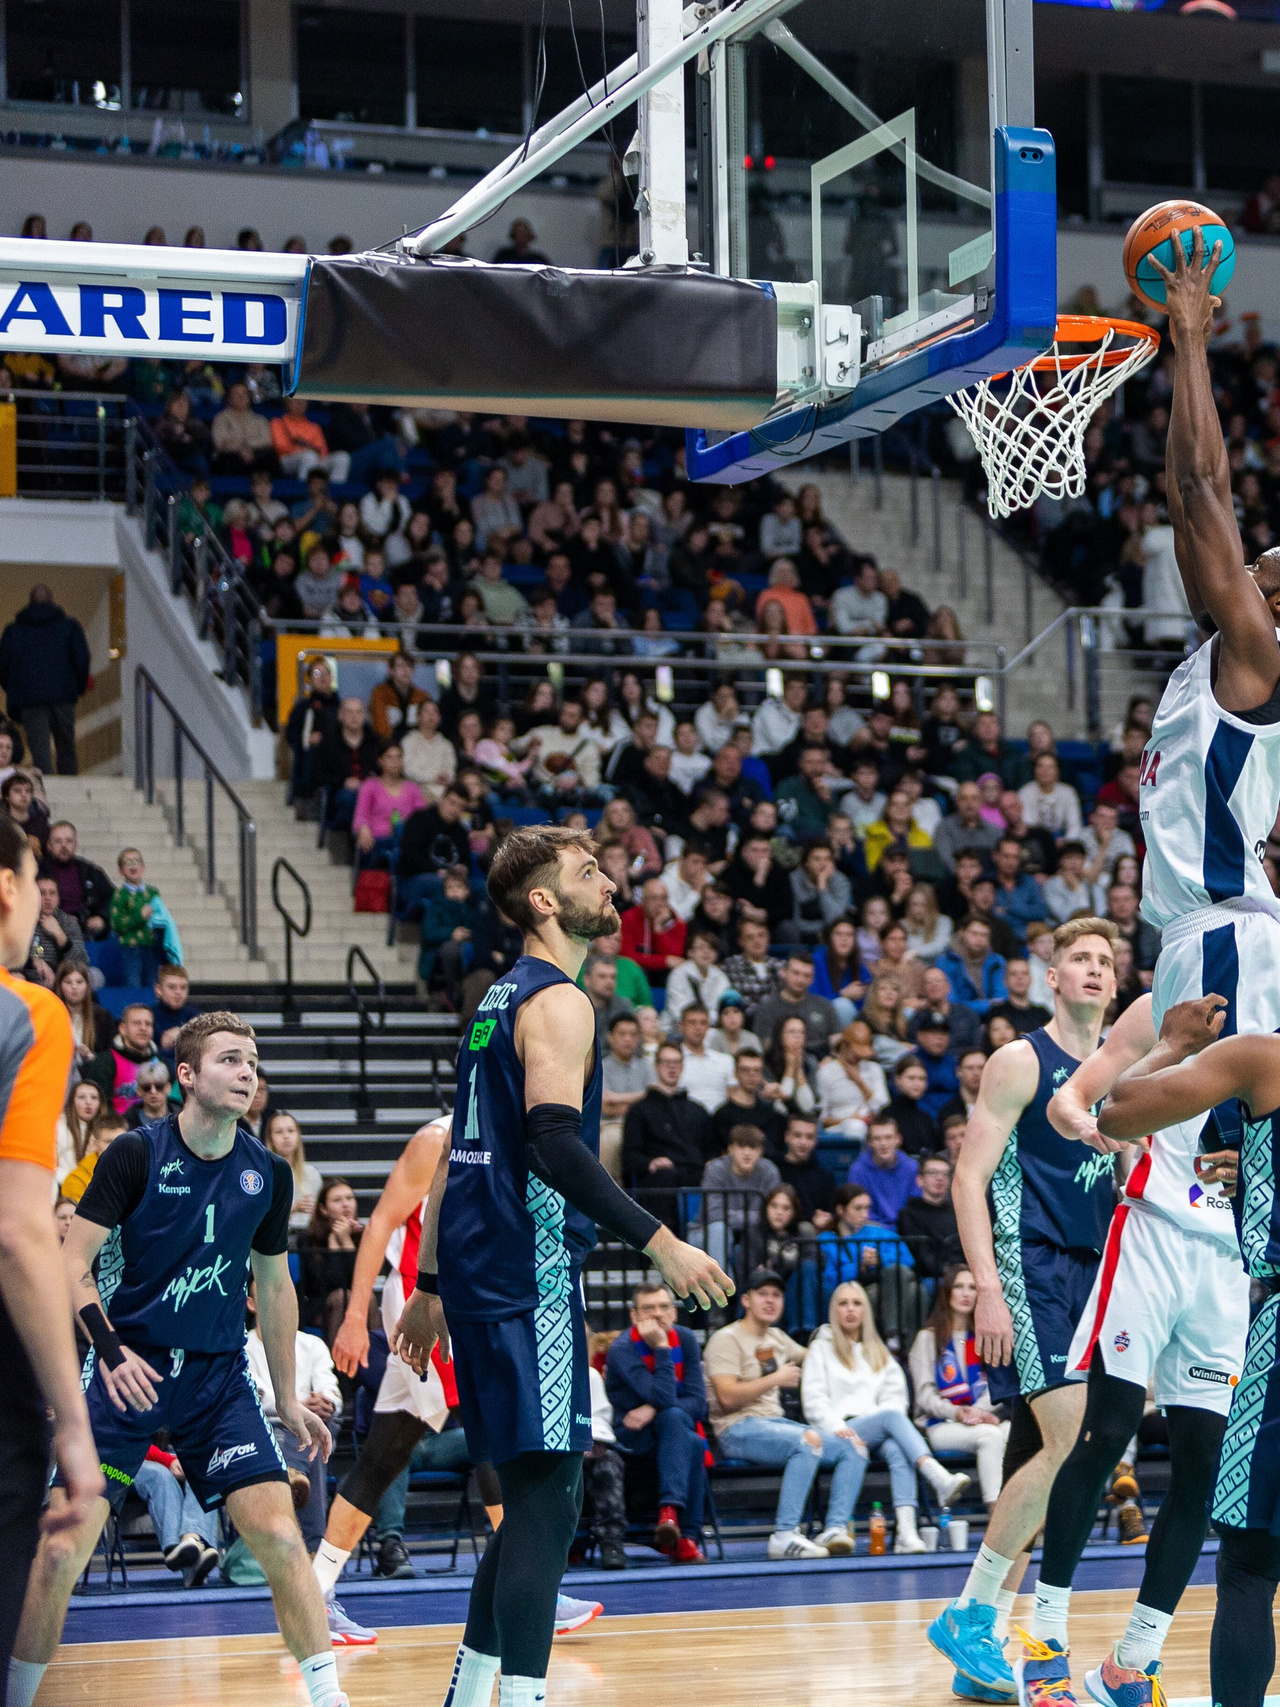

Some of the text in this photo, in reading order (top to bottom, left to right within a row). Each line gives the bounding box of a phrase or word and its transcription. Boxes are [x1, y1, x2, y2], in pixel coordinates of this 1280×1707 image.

[0, 281, 288, 346] ARED
[158, 1183, 191, 1196] Kempa
[203, 1204, 215, 1243] 1
[1192, 1368, 1227, 1382] Winline
